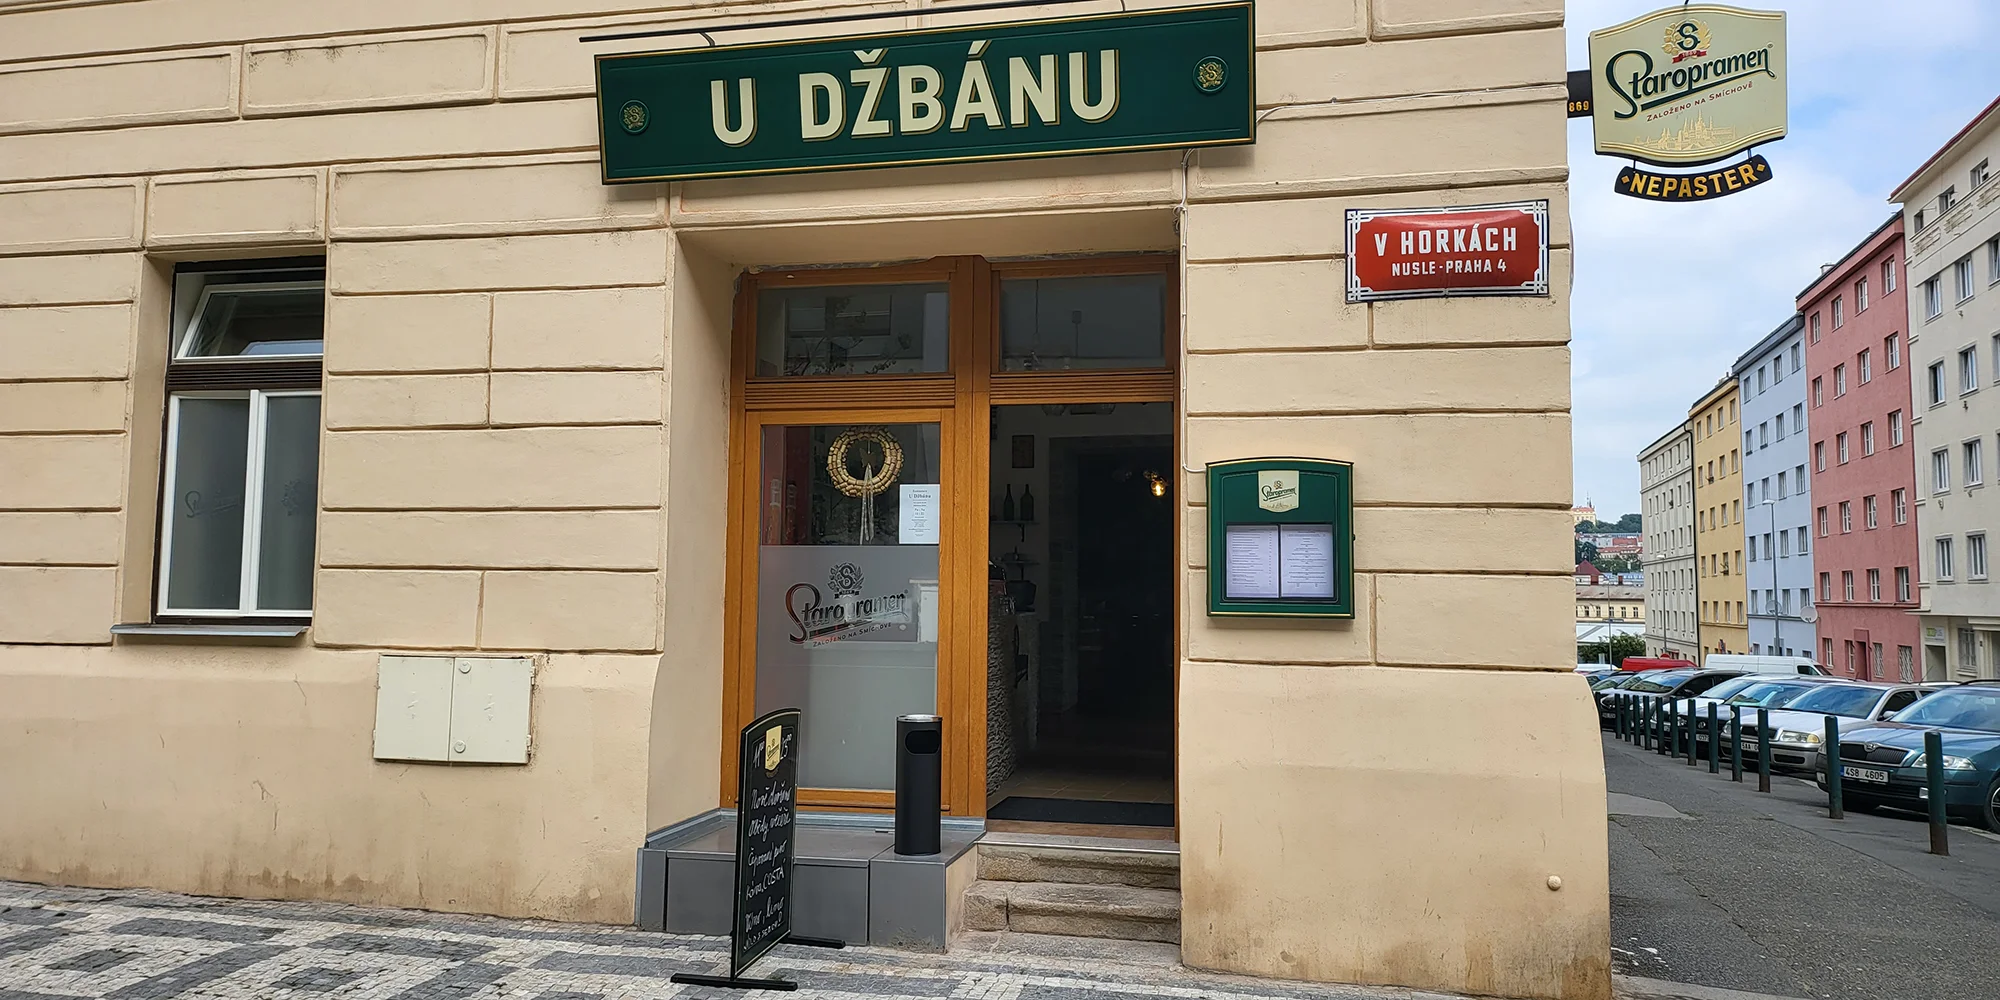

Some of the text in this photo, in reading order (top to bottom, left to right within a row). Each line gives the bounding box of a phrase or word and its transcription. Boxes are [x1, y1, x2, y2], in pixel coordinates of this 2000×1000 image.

[710, 40, 1120, 147] U DŽBÁNU
[1605, 49, 1777, 120] Staropramen
[1646, 80, 1753, 122] ZALOŽENO NA SMÍCHOVĚ
[1629, 163, 1759, 198] NEPASTER
[1374, 223, 1517, 257] V HORKÁCH
[1497, 258, 1507, 272] 4
[859, 622, 892, 635] SMÍCOVĚ
[1845, 768, 1885, 781] 4S8 4605
